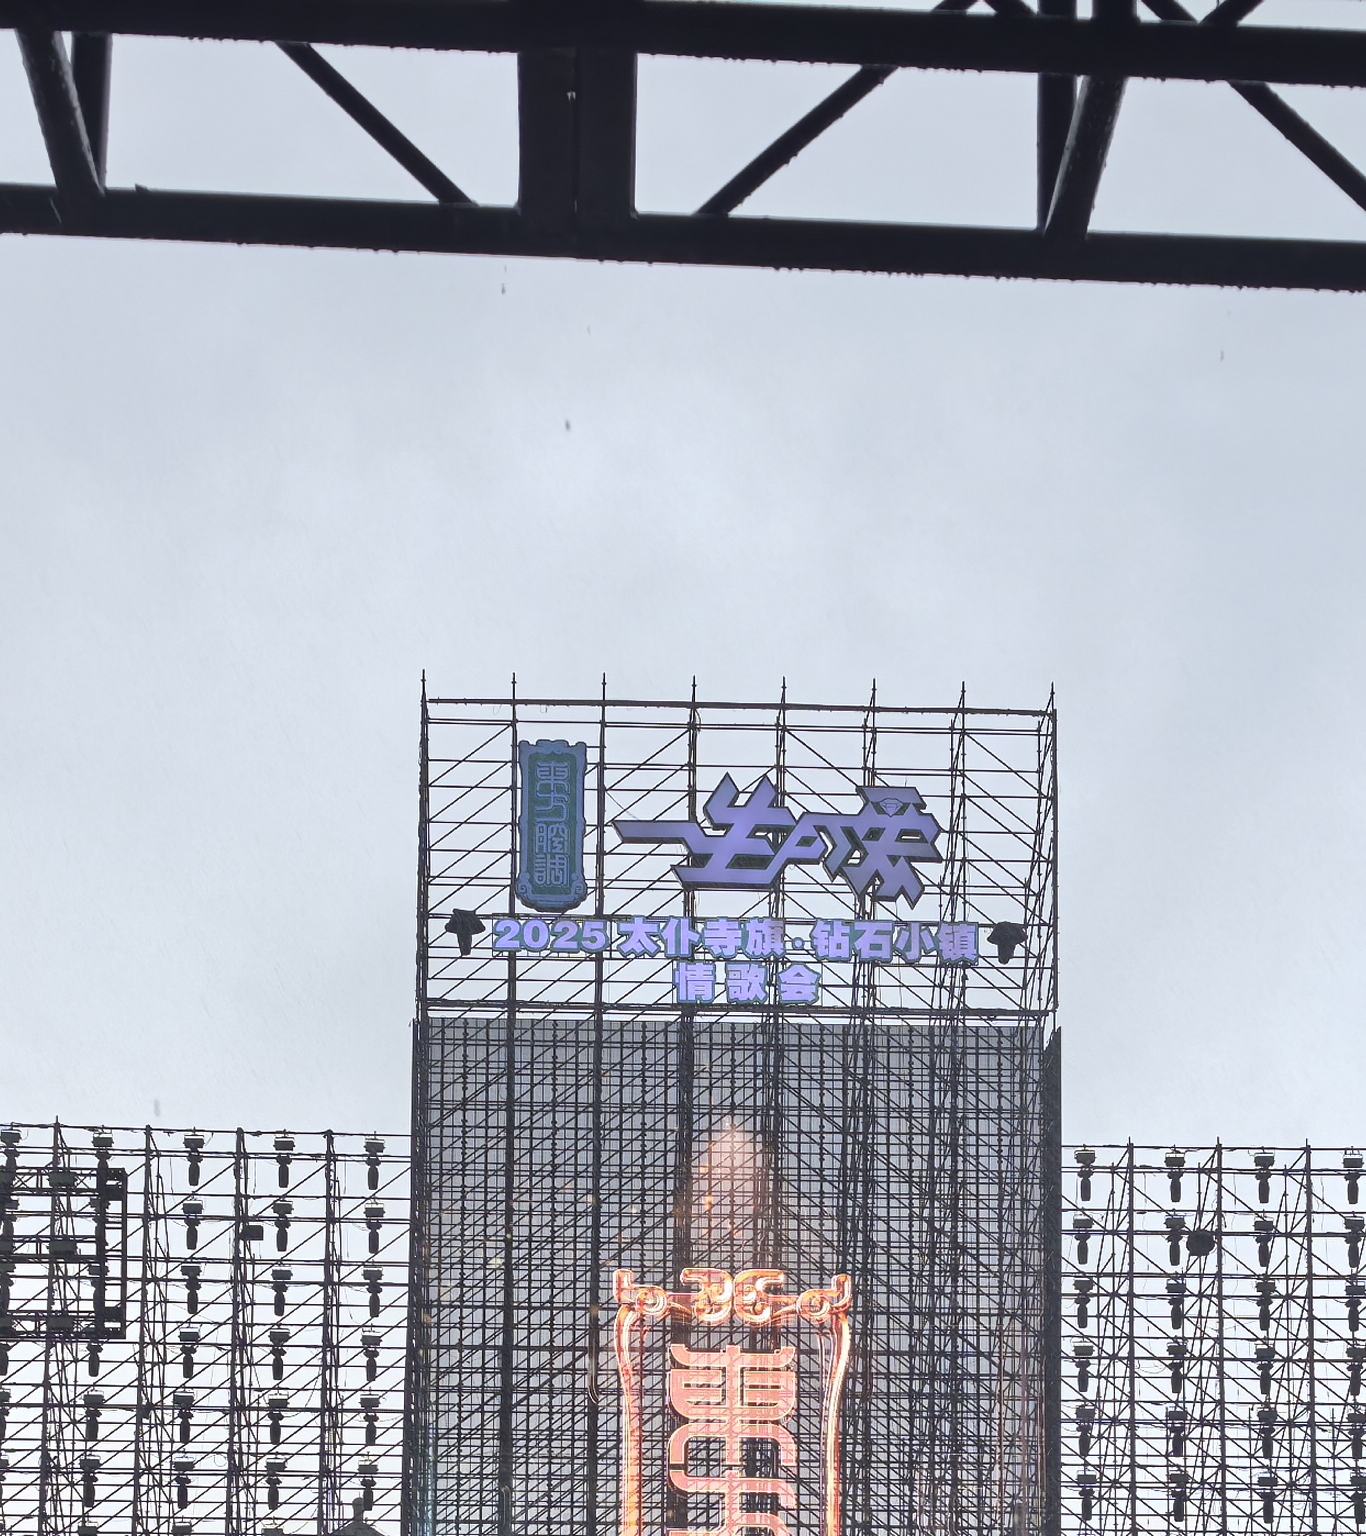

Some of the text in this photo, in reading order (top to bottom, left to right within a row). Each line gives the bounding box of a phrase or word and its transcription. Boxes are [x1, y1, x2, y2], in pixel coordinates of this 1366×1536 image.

[494, 918, 608, 953] 2025
[674, 961, 822, 1004] 情歌会
